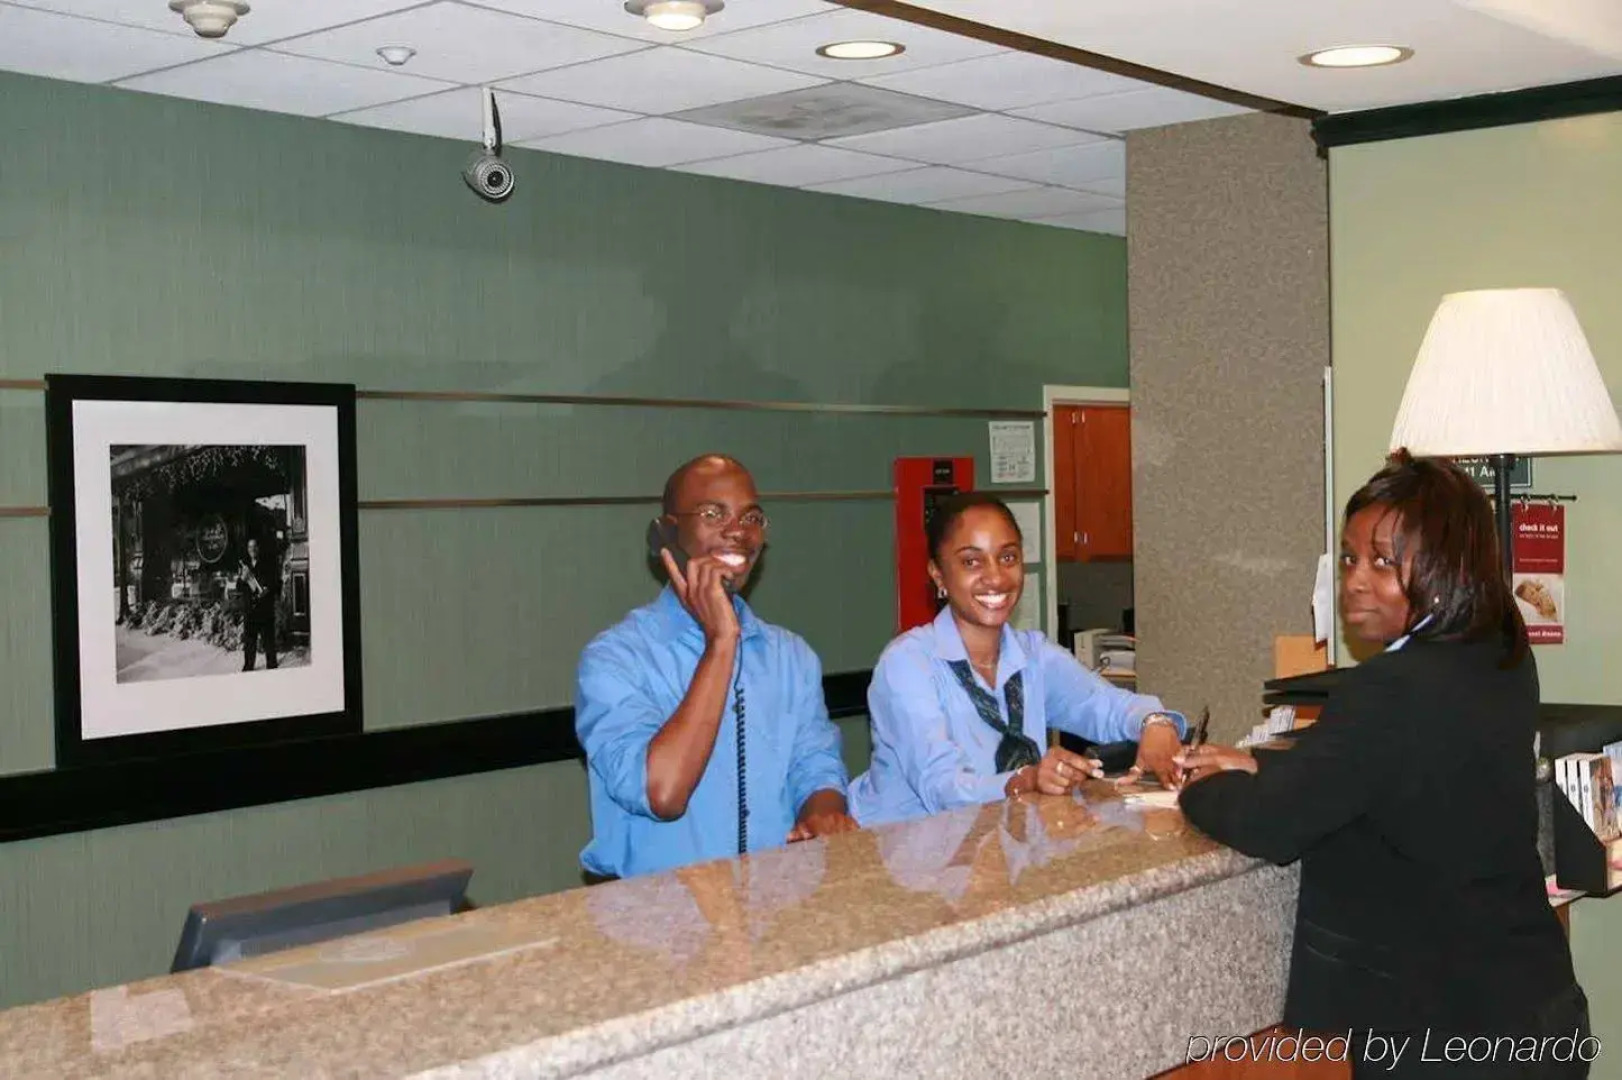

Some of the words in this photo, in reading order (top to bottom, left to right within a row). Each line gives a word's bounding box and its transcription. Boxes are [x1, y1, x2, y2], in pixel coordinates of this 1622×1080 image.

[1519, 523, 1538, 532] check
[1539, 523, 1545, 532] it
[1546, 524, 1559, 532] out
